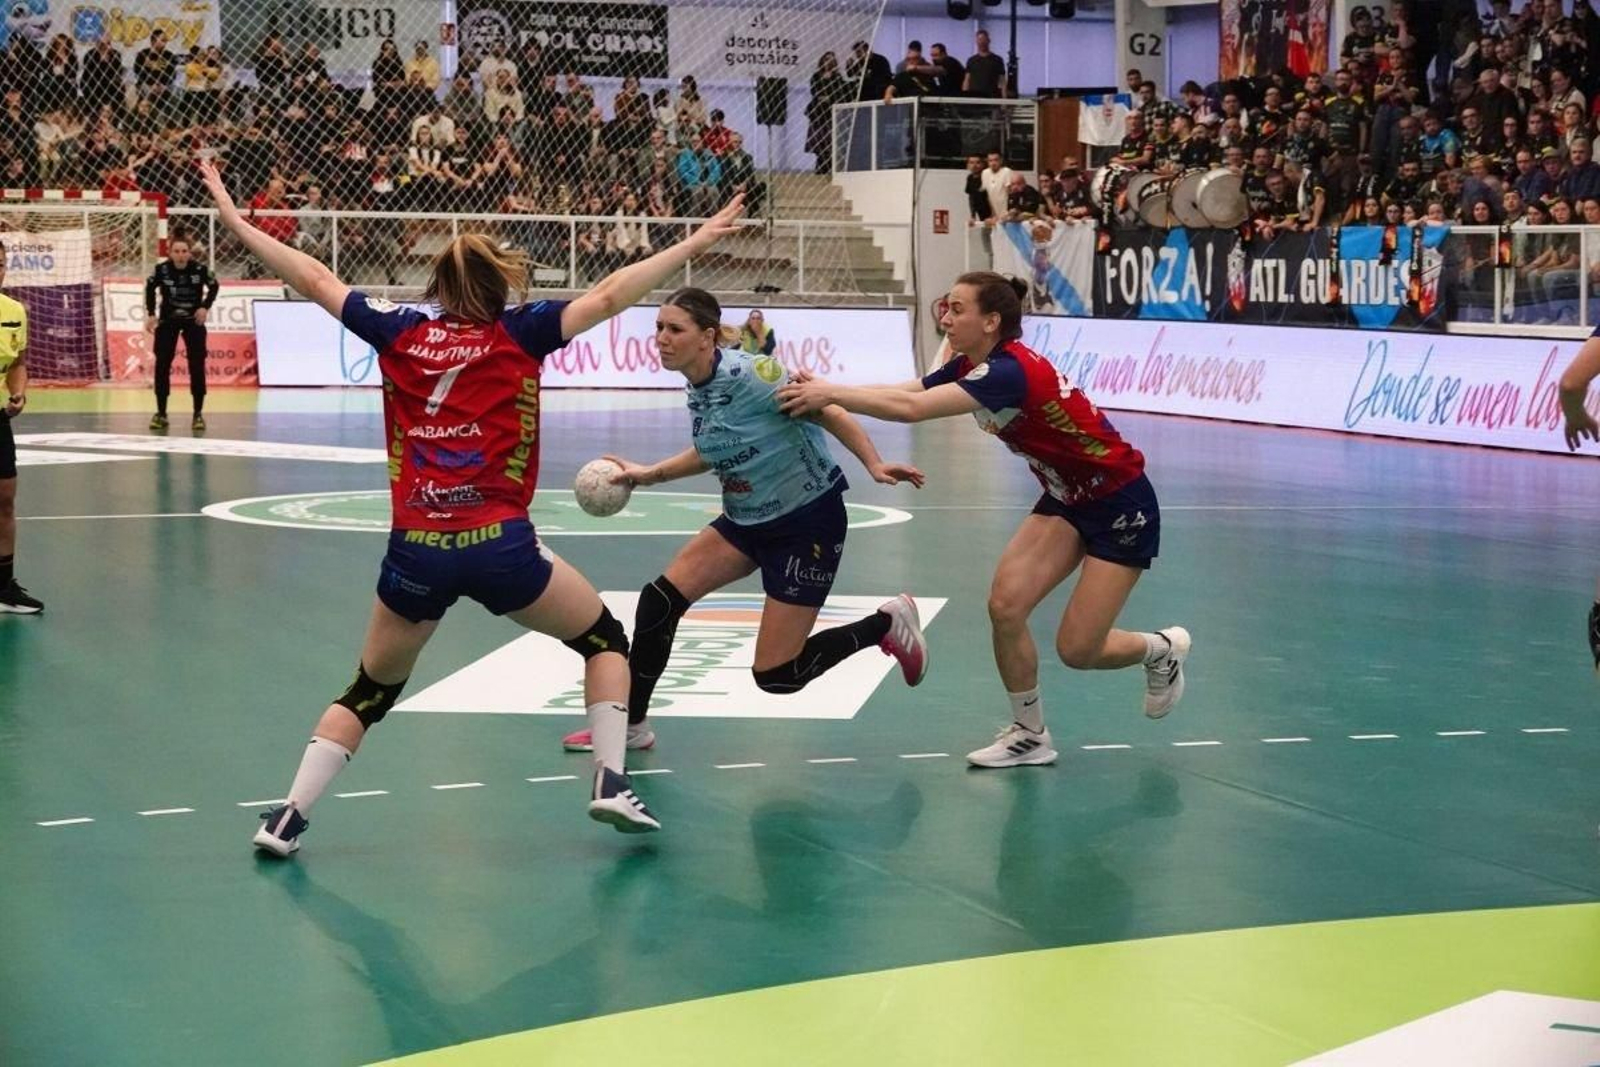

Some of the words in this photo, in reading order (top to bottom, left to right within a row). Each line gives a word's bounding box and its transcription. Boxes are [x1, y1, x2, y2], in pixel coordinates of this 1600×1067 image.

[725, 34, 798, 49] deportes
[1129, 33, 1162, 56] G2
[1105, 242, 1214, 312] FORZA!
[1250, 258, 1295, 302] ATL.
[422, 362, 467, 417] 7
[1138, 325, 1173, 396] las
[1344, 339, 1434, 428] Donde
[1428, 376, 1461, 426] se
[1456, 381, 1520, 430] unen
[1525, 345, 1562, 431] las
[504, 377, 537, 485] Mecalia
[1112, 511, 1147, 530] 44
